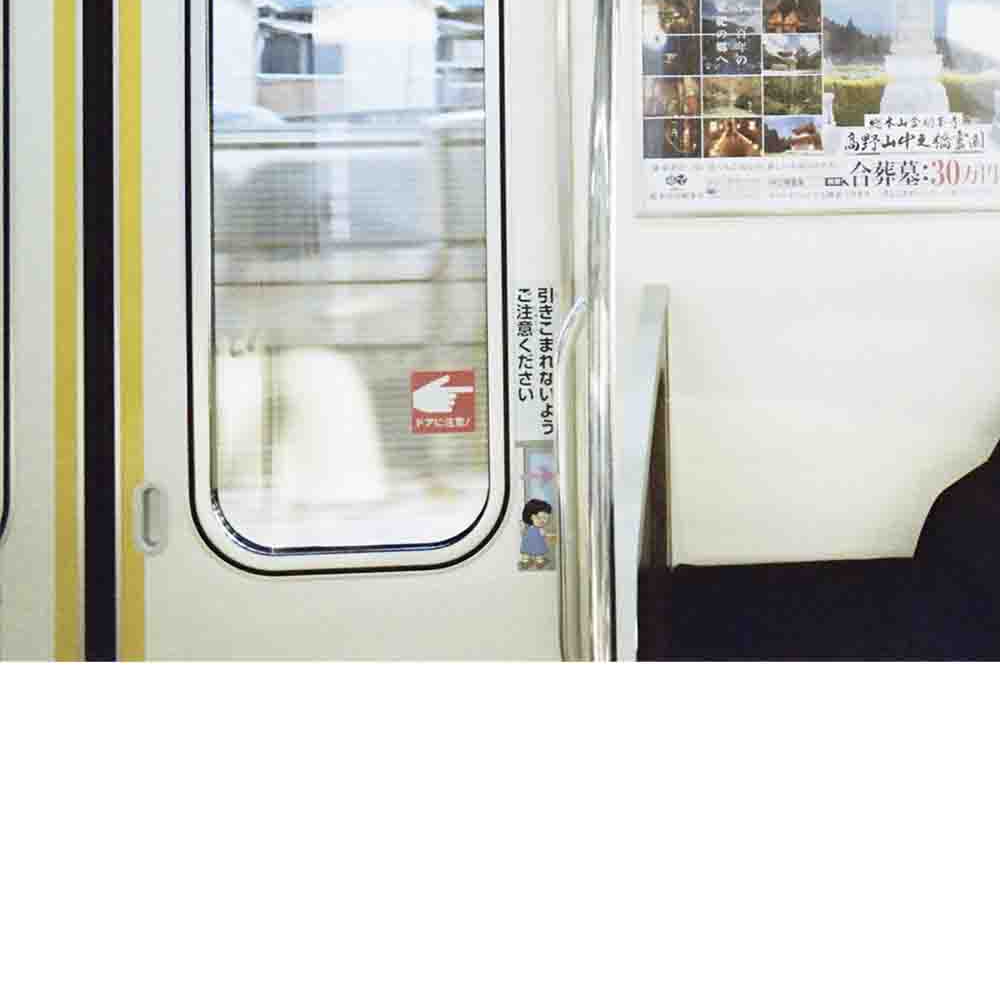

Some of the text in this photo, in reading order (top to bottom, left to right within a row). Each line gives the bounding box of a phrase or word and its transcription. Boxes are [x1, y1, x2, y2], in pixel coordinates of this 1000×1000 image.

[517, 287, 534, 403] ご注意ください
[538, 287, 554, 435] 引きこまれないよう
